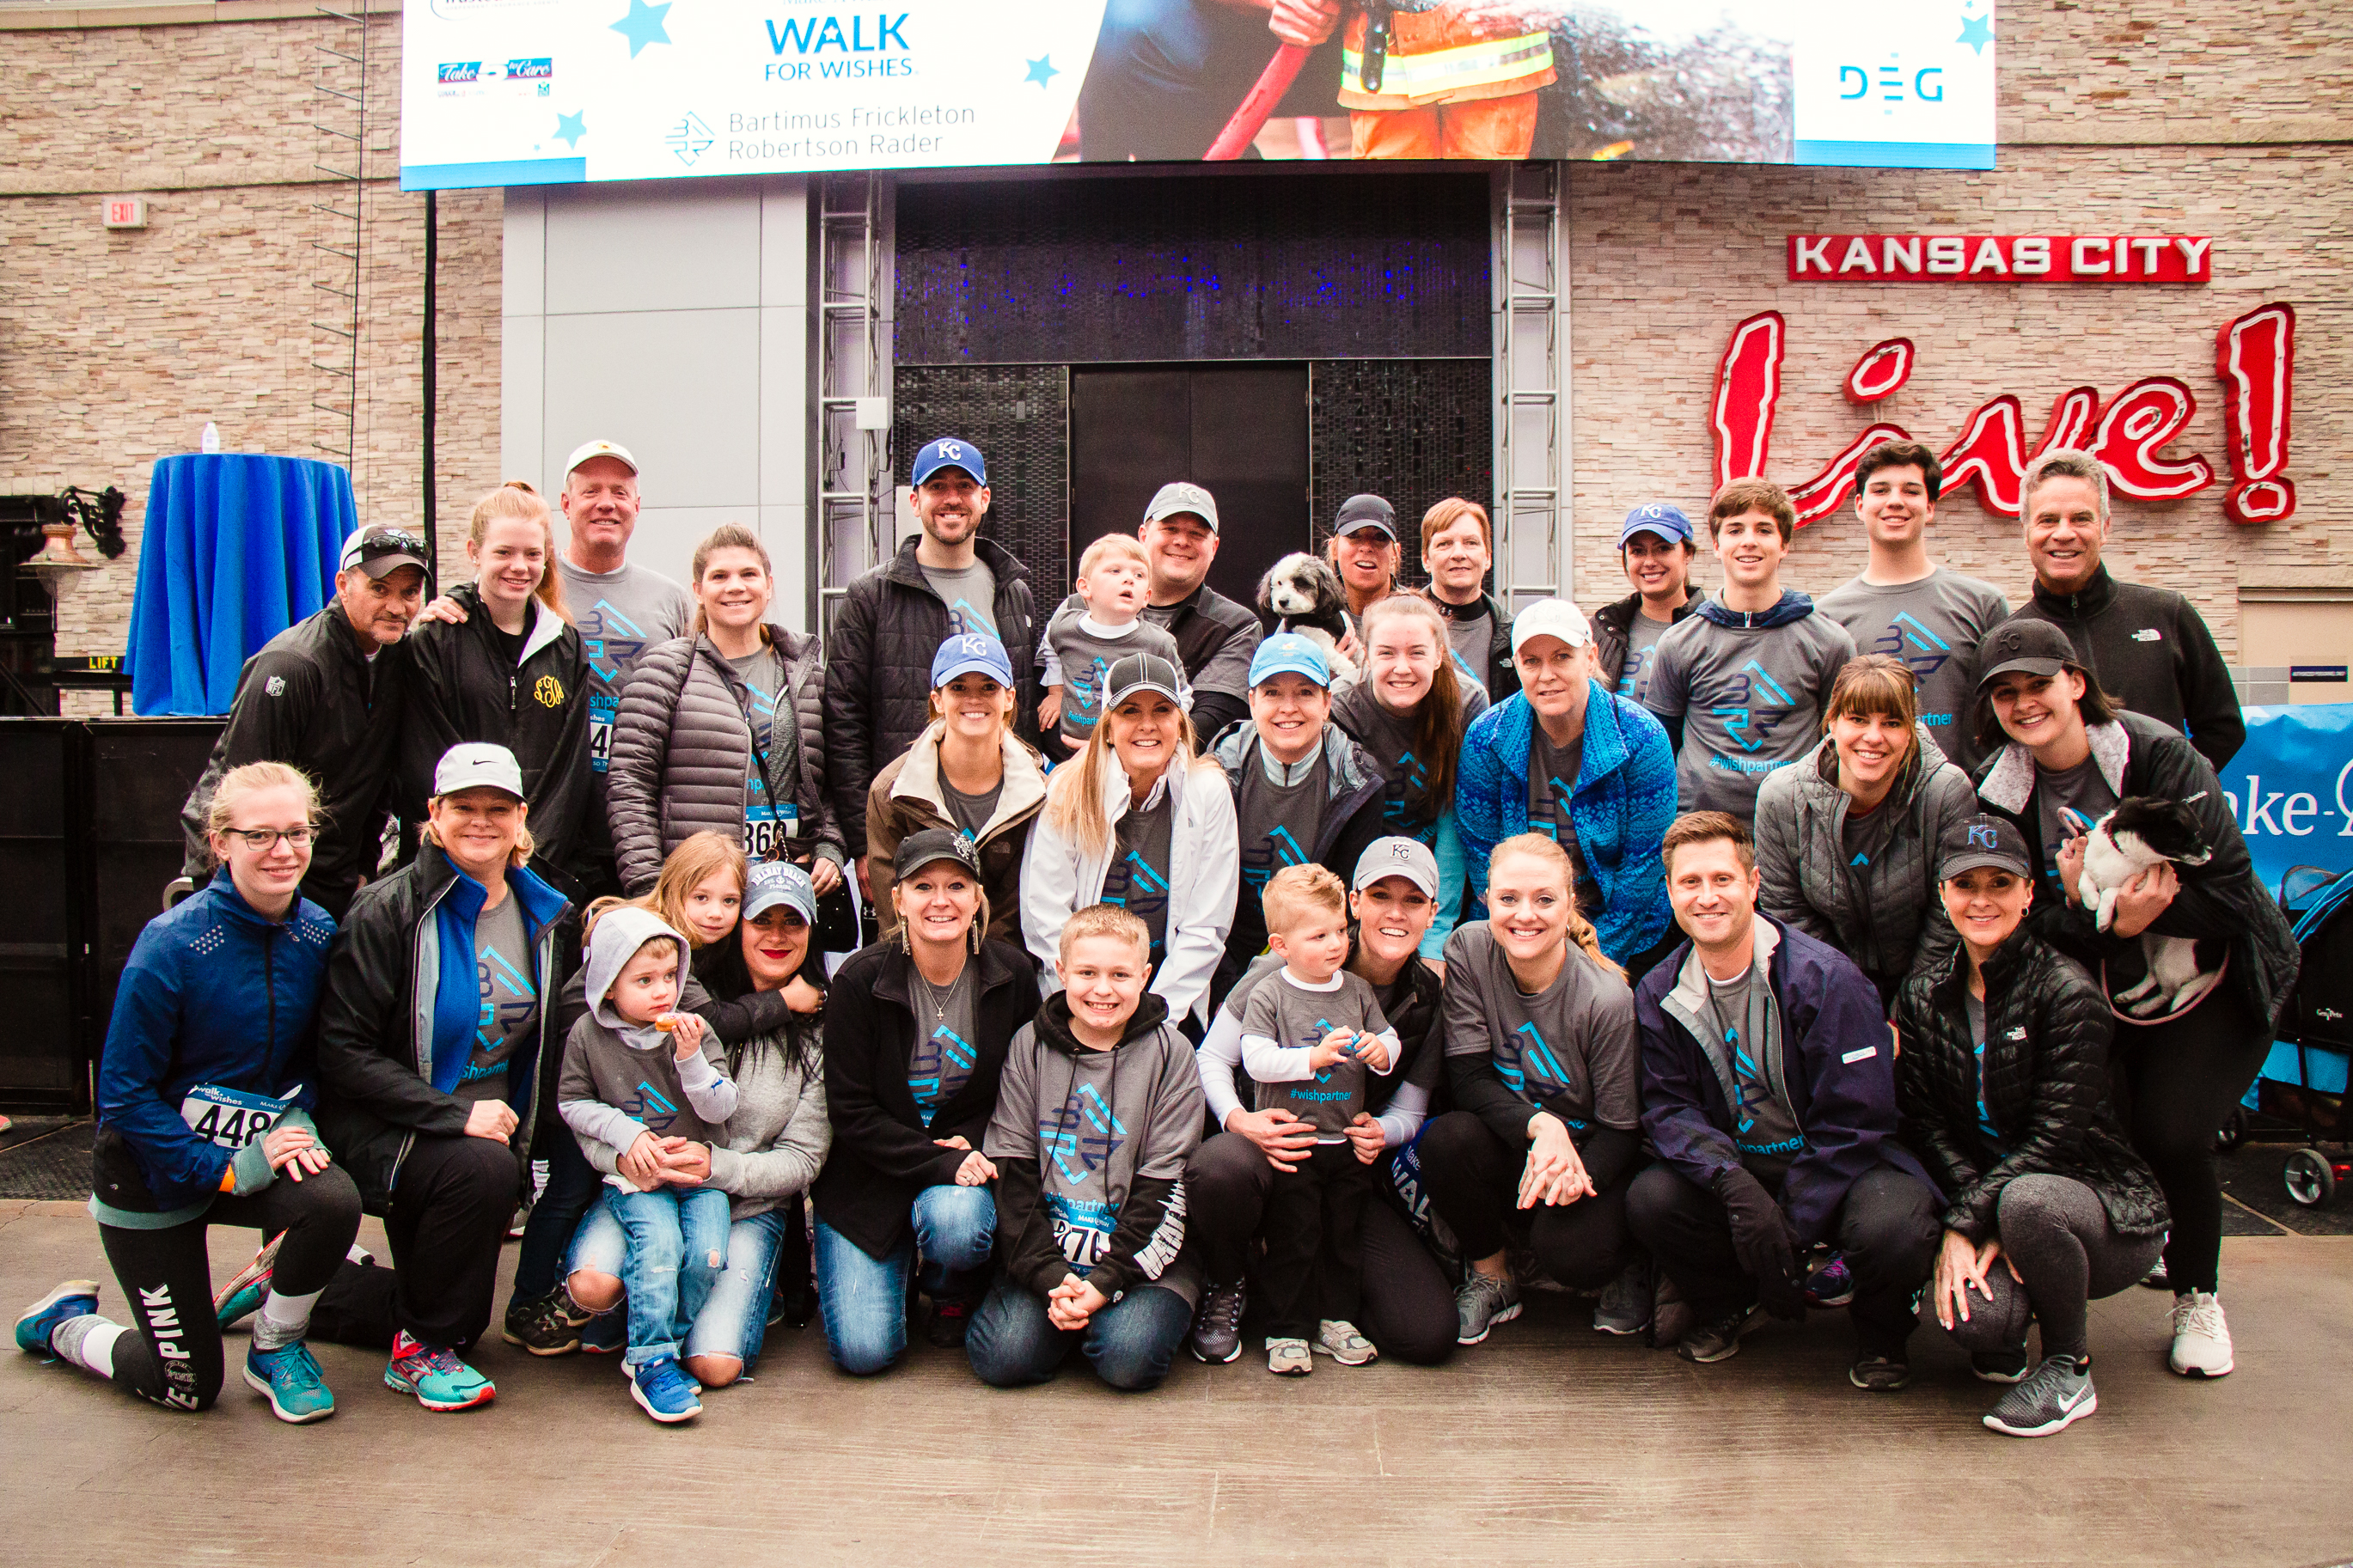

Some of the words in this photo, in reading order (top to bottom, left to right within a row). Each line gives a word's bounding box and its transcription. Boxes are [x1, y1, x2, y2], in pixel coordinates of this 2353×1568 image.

[765, 13, 910, 56] WALK
[439, 64, 476, 82] Take
[516, 59, 551, 78] Care
[766, 63, 811, 82] FOR
[820, 58, 913, 79] WISHES
[730, 110, 841, 132] Bartimus
[853, 104, 975, 127] Frickleton
[730, 137, 858, 160] Robertson
[871, 133, 944, 155] Rader
[111, 201, 135, 223] EXIT
[1794, 237, 2052, 276] KANSAS
[2069, 236, 2211, 276] CITY
[938, 441, 962, 461] KC
[962, 637, 987, 656] KC
[89, 656, 119, 669] LIFT
[1967, 825, 1998, 849] KC
[1391, 844, 1410, 860] KC
[210, 1095, 243, 1106] wishes
[1290, 1089, 1352, 1104] #wishpartner
[138, 1283, 191, 1359] PINK
